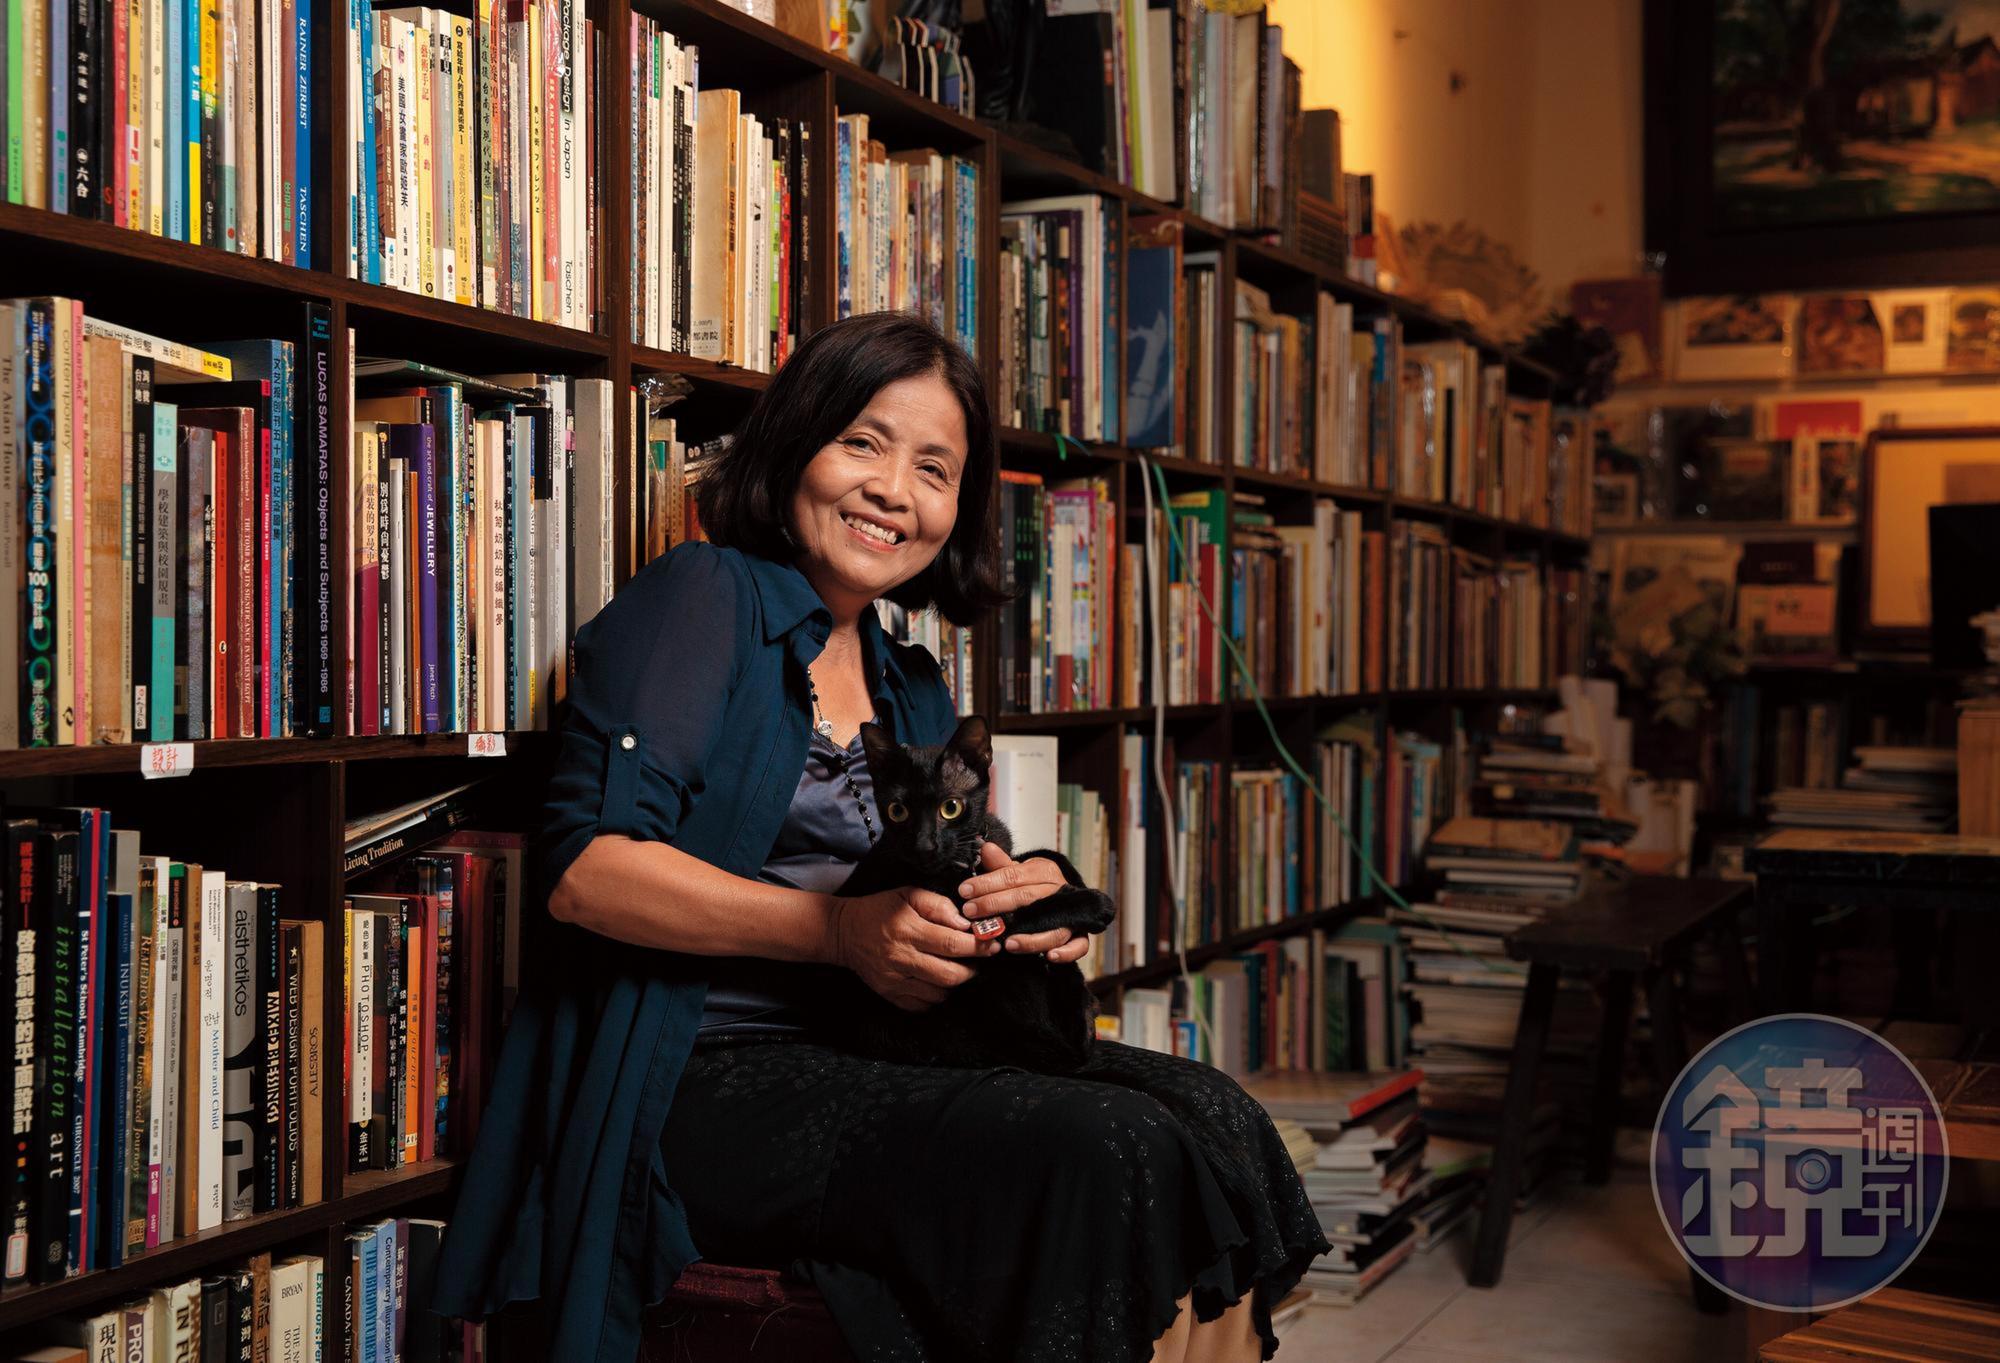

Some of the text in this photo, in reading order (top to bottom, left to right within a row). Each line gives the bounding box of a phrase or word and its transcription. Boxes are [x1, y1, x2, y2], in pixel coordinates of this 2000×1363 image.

[299, 17, 308, 129] RAINER ZERBST
[562, 66, 572, 113] Design
[563, 119, 572, 131] in
[563, 136, 574, 179] Japan
[76, 167, 89, 199] 六合
[299, 186, 308, 252] TASCHEN
[562, 260, 573, 314] Taschen
[2, 356, 13, 385] The
[317, 351, 328, 402] LUCAS
[2, 390, 13, 437] Asian
[62, 329, 73, 521] contemporary natural
[2, 442, 13, 490] House
[318, 405, 328, 485] SAMARAS:
[317, 487, 328, 540] Objects
[427, 494, 433, 502] of
[319, 543, 329, 570] and
[426, 503, 435, 577] JEWELLERY
[28, 571, 48, 586] 100
[318, 572, 329, 632] Subjects
[243, 588, 251, 643] SIGNIFICANCE
[243, 653, 251, 682] ANCIENT
[428, 664, 436, 682] Janet
[243, 683, 251, 704] EGYPT
[152, 746, 178, 775] 設計
[367, 837, 404, 863] Tradition
[76, 930, 89, 1083] St Peter's School, Cambridge
[119, 962, 129, 1029] INUKSUIT
[289, 973, 298, 1005] WEB
[361, 964, 370, 1052] PHOTOSHOP
[49, 925, 74, 1179] installation art
[132, 935, 153, 1179] REMEDIOS VARO Unexpected Journeys
[212, 1029, 220, 1071] Mother
[289, 1008, 298, 1063] DESIGN:
[309, 1026, 318, 1097] A.LESBROS
[211, 1099, 219, 1130] Child
[288, 1066, 298, 1152] PORTFOLIOS
[72, 1115, 82, 1194] CHRONICLE 2007
[359, 1131, 369, 1156] 金禾
[365, 1245, 378, 1274] THE
[384, 1236, 393, 1303] Contemporary
[281, 1282, 303, 1299] BRYAN
[176, 1306, 190, 1331] IN
[344, 1275, 352, 1357] CANADA: The
[100, 1323, 117, 1363] 現代
